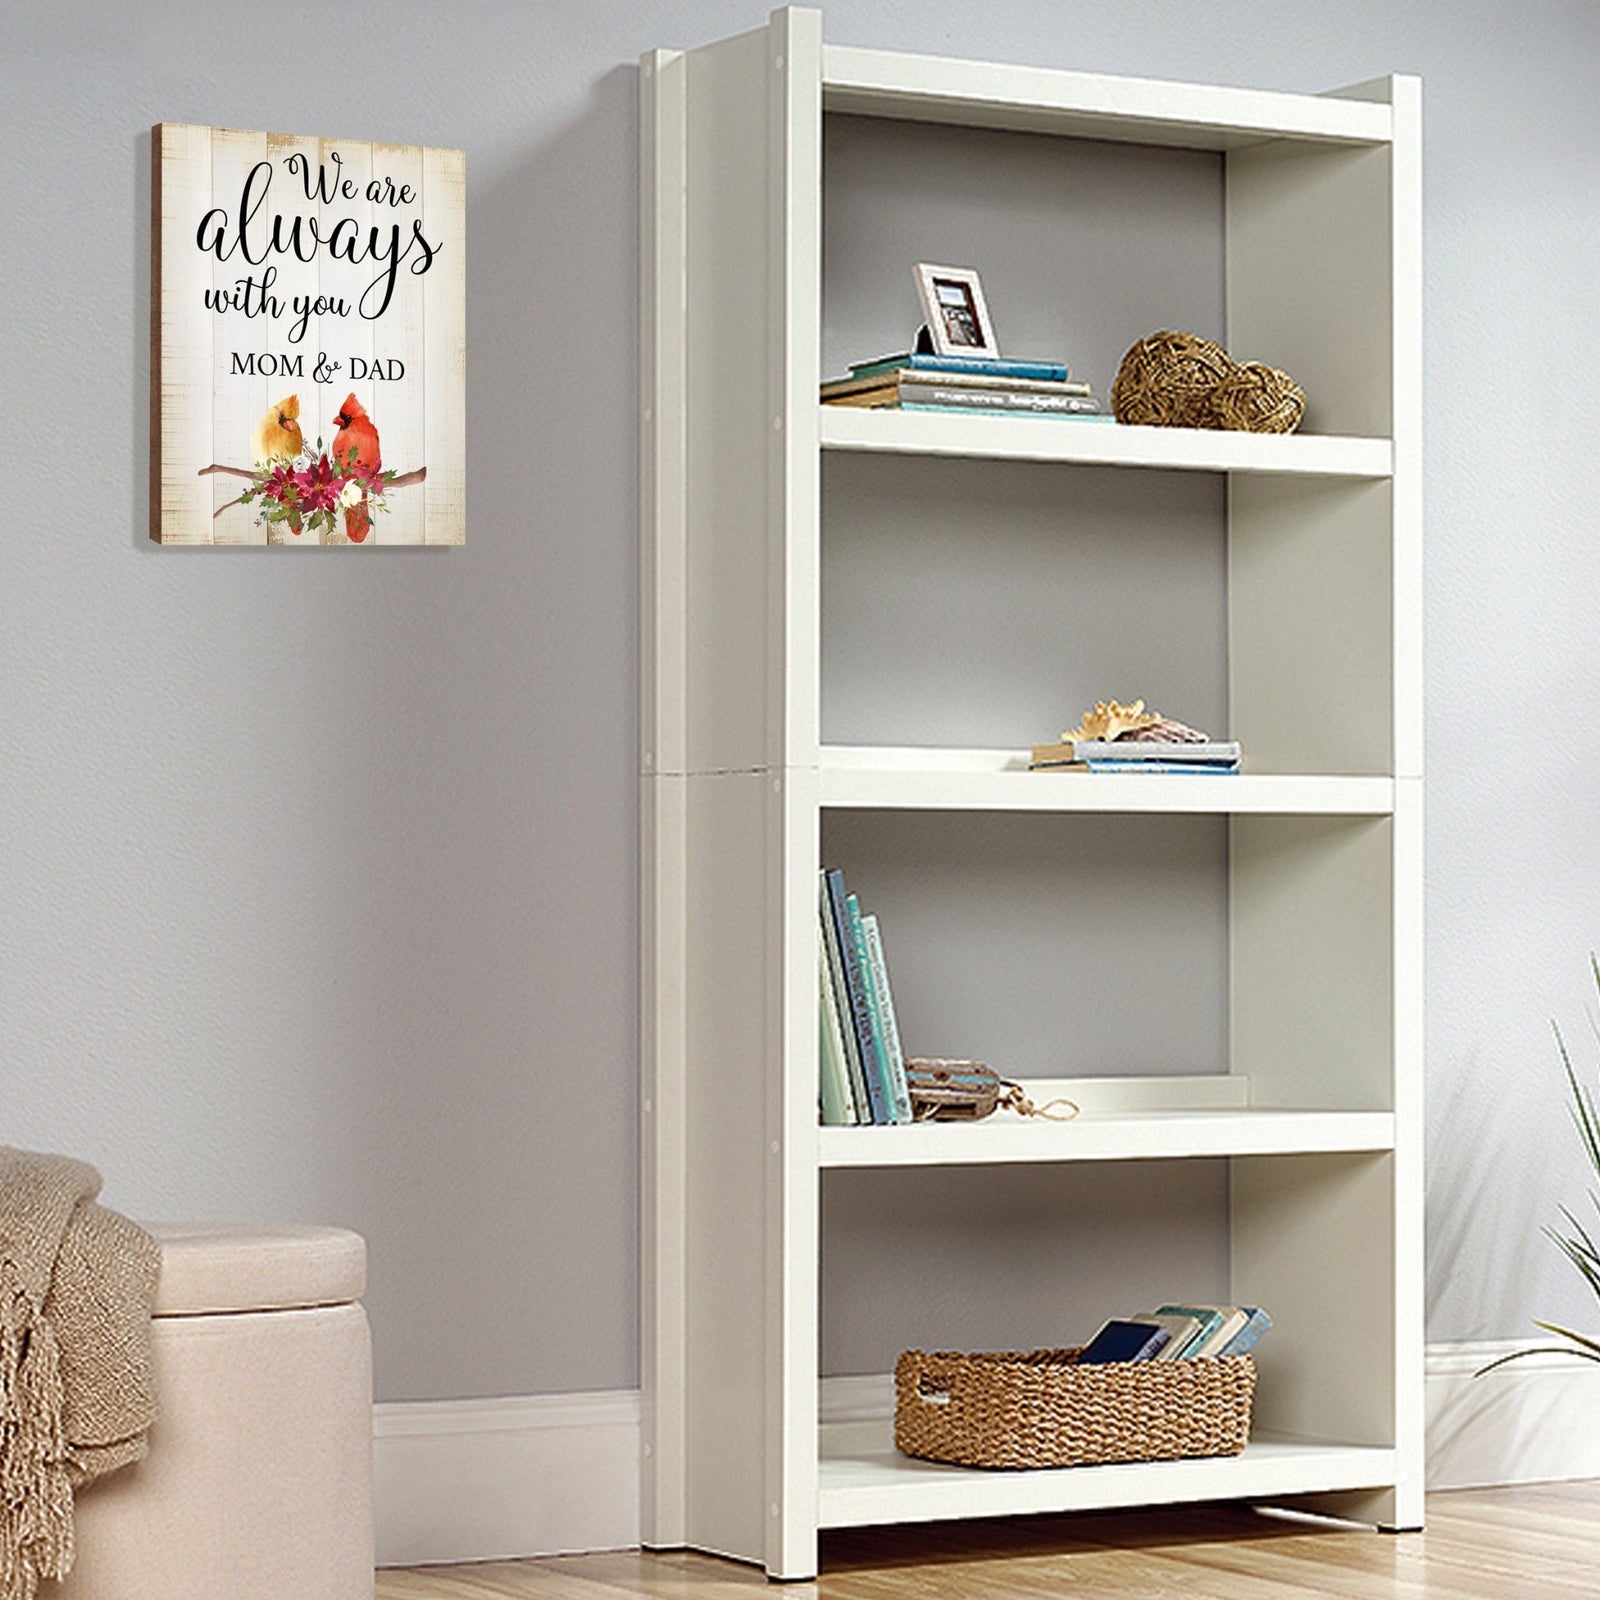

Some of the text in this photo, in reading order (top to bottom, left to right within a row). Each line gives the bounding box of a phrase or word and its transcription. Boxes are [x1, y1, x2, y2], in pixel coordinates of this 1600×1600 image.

[283, 152, 417, 208] We are
[196, 161, 444, 321] always
[204, 266, 352, 344] with you
[229, 352, 405, 384] MOM & DAD
